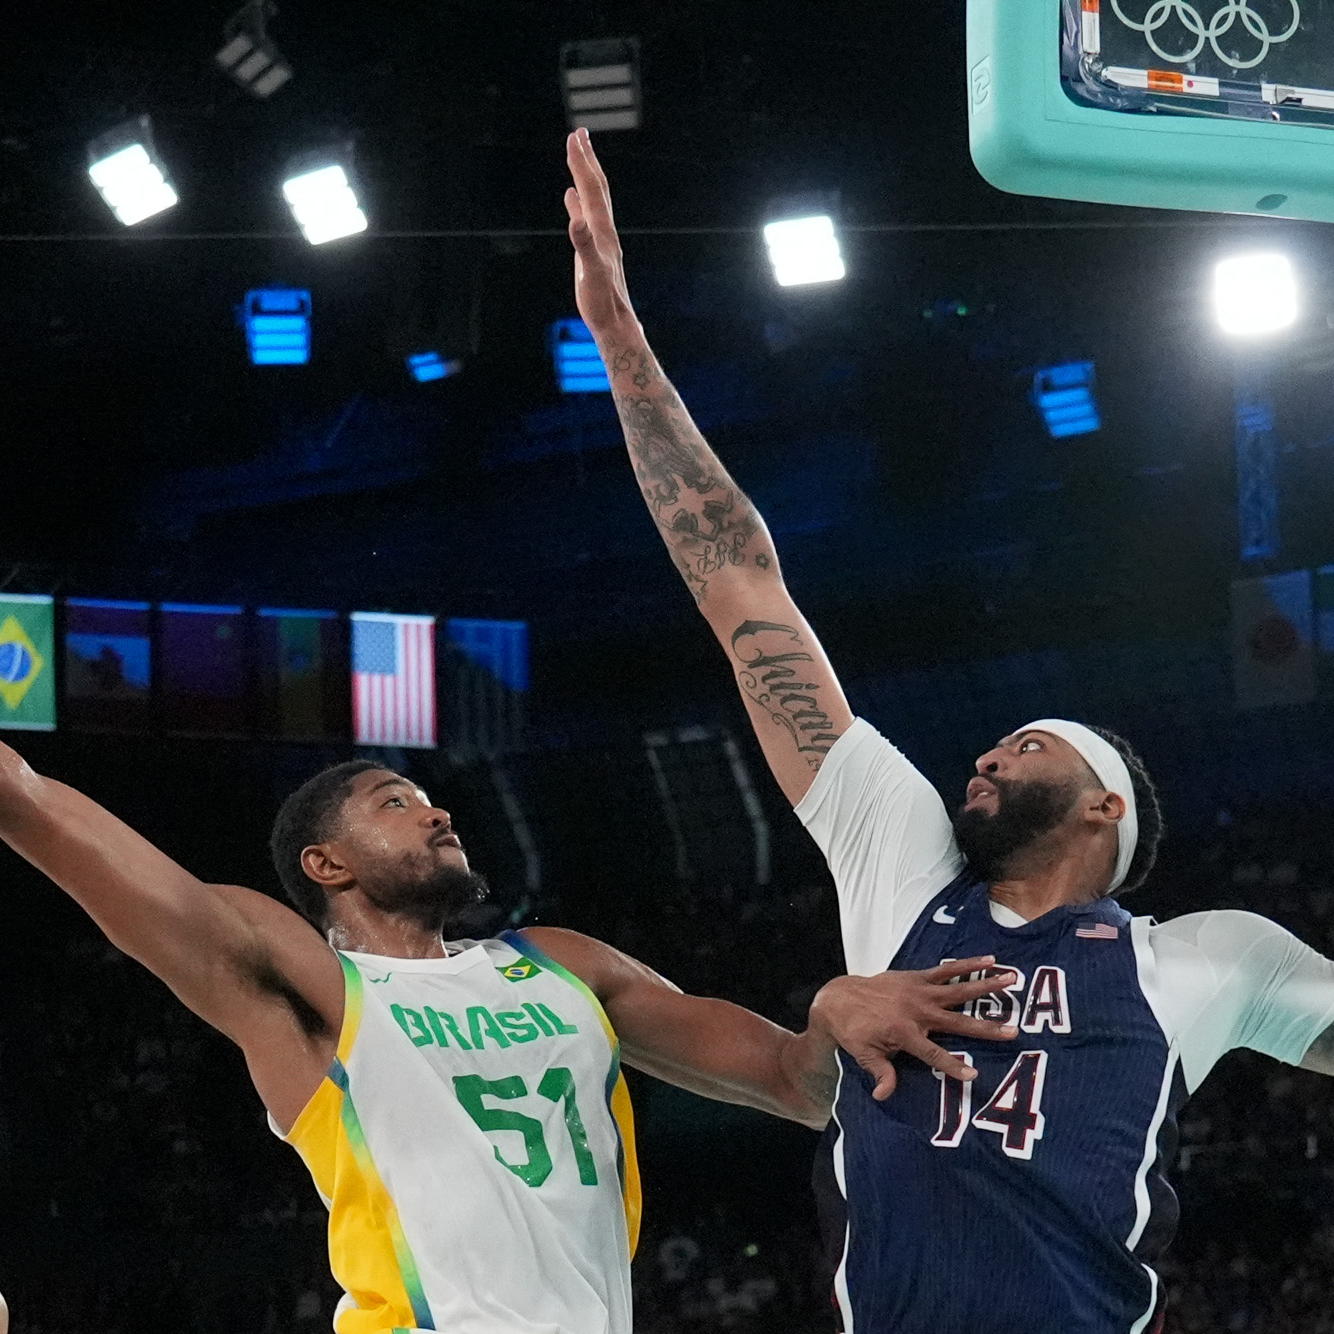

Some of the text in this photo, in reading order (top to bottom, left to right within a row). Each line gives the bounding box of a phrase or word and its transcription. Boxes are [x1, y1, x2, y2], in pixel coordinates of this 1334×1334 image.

[731, 619, 841, 753] Chicag
[389, 1002, 579, 1051] BRASIL
[451, 1066, 599, 1188] 51
[930, 1050, 1049, 1160] 14
